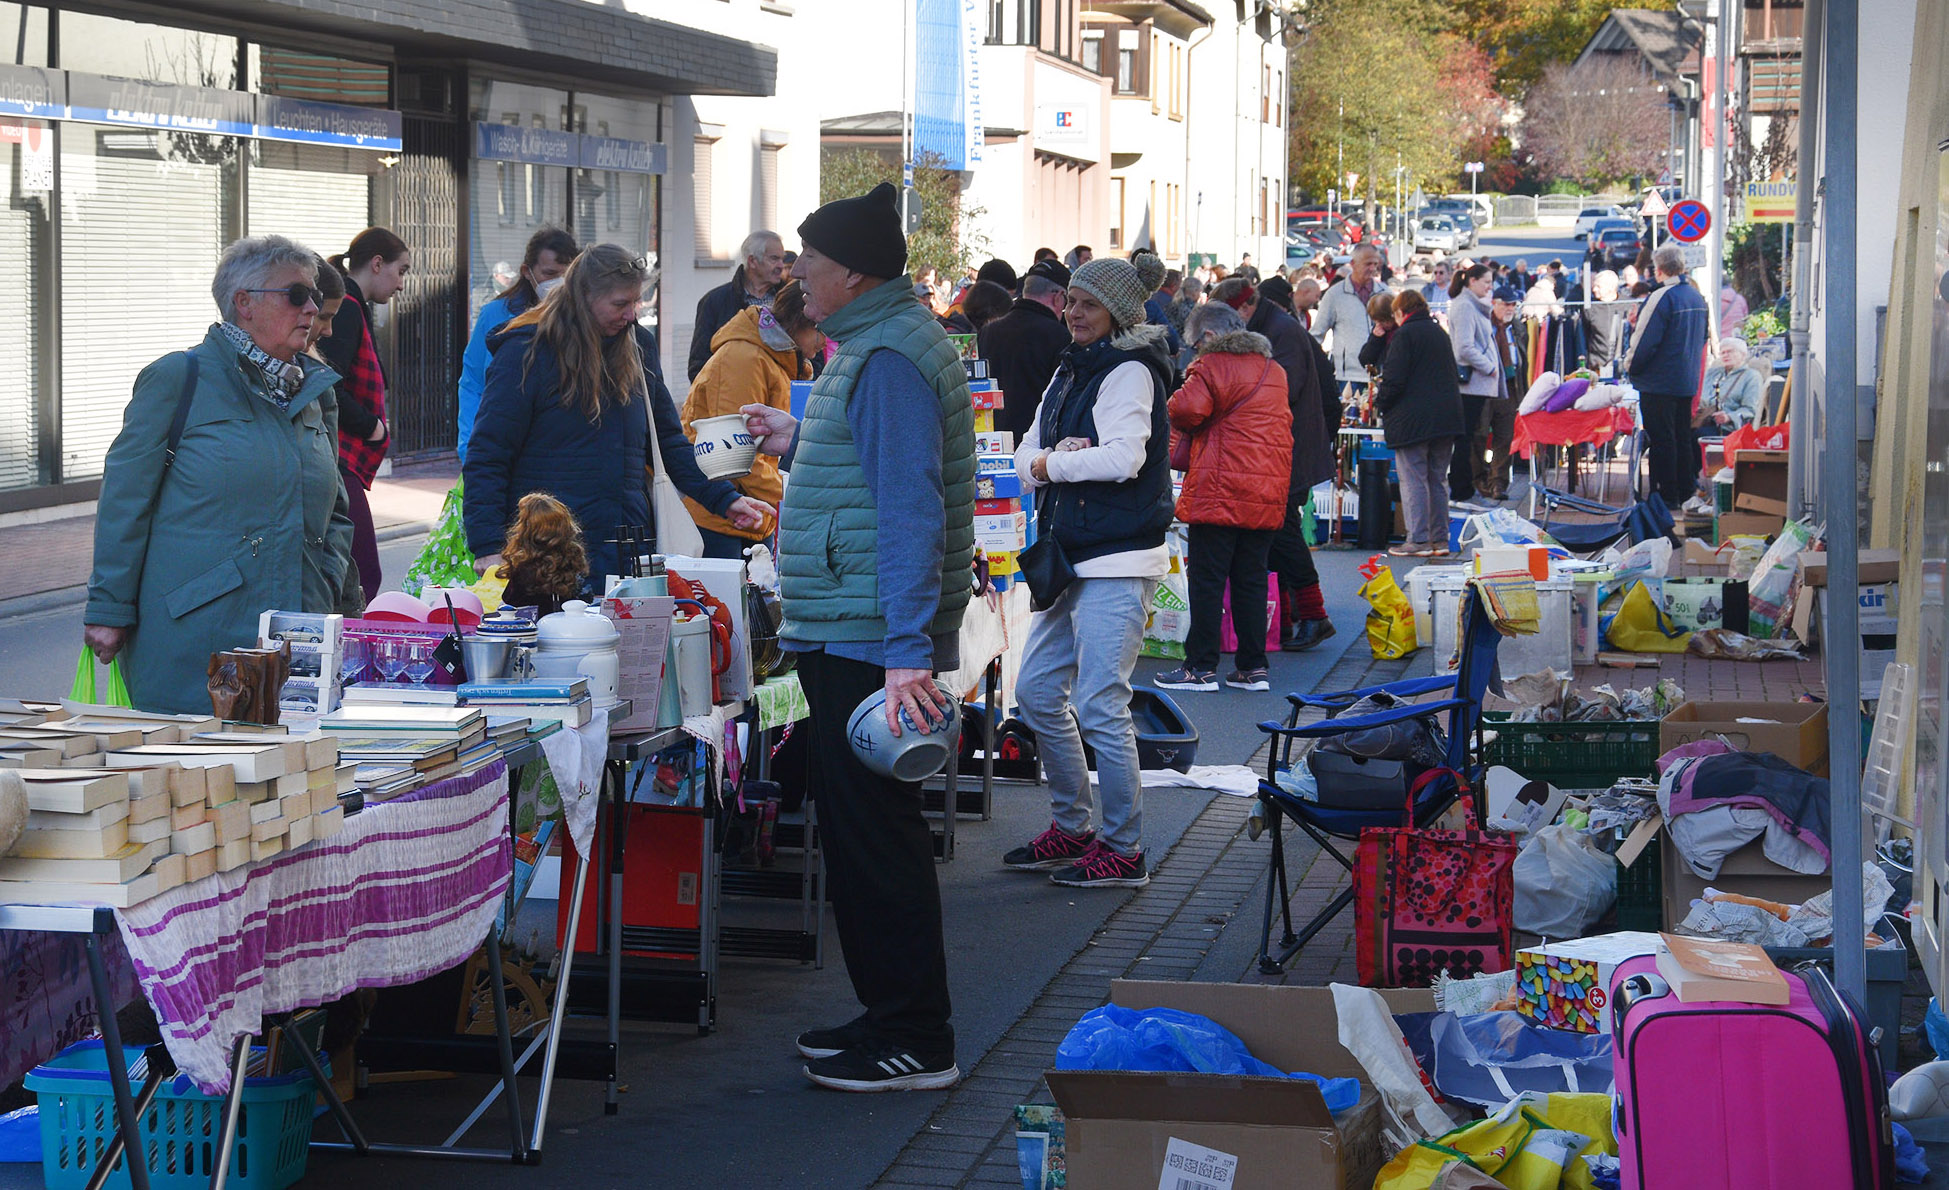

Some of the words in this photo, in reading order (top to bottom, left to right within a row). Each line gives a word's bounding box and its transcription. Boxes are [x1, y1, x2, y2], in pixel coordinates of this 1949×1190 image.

[969, 22, 982, 162] Frankfurter
[273, 104, 322, 133] Leuchten
[331, 112, 388, 144] Hausgeräte
[491, 131, 520, 153] Wasch-
[529, 133, 568, 160] Kühlgeräte
